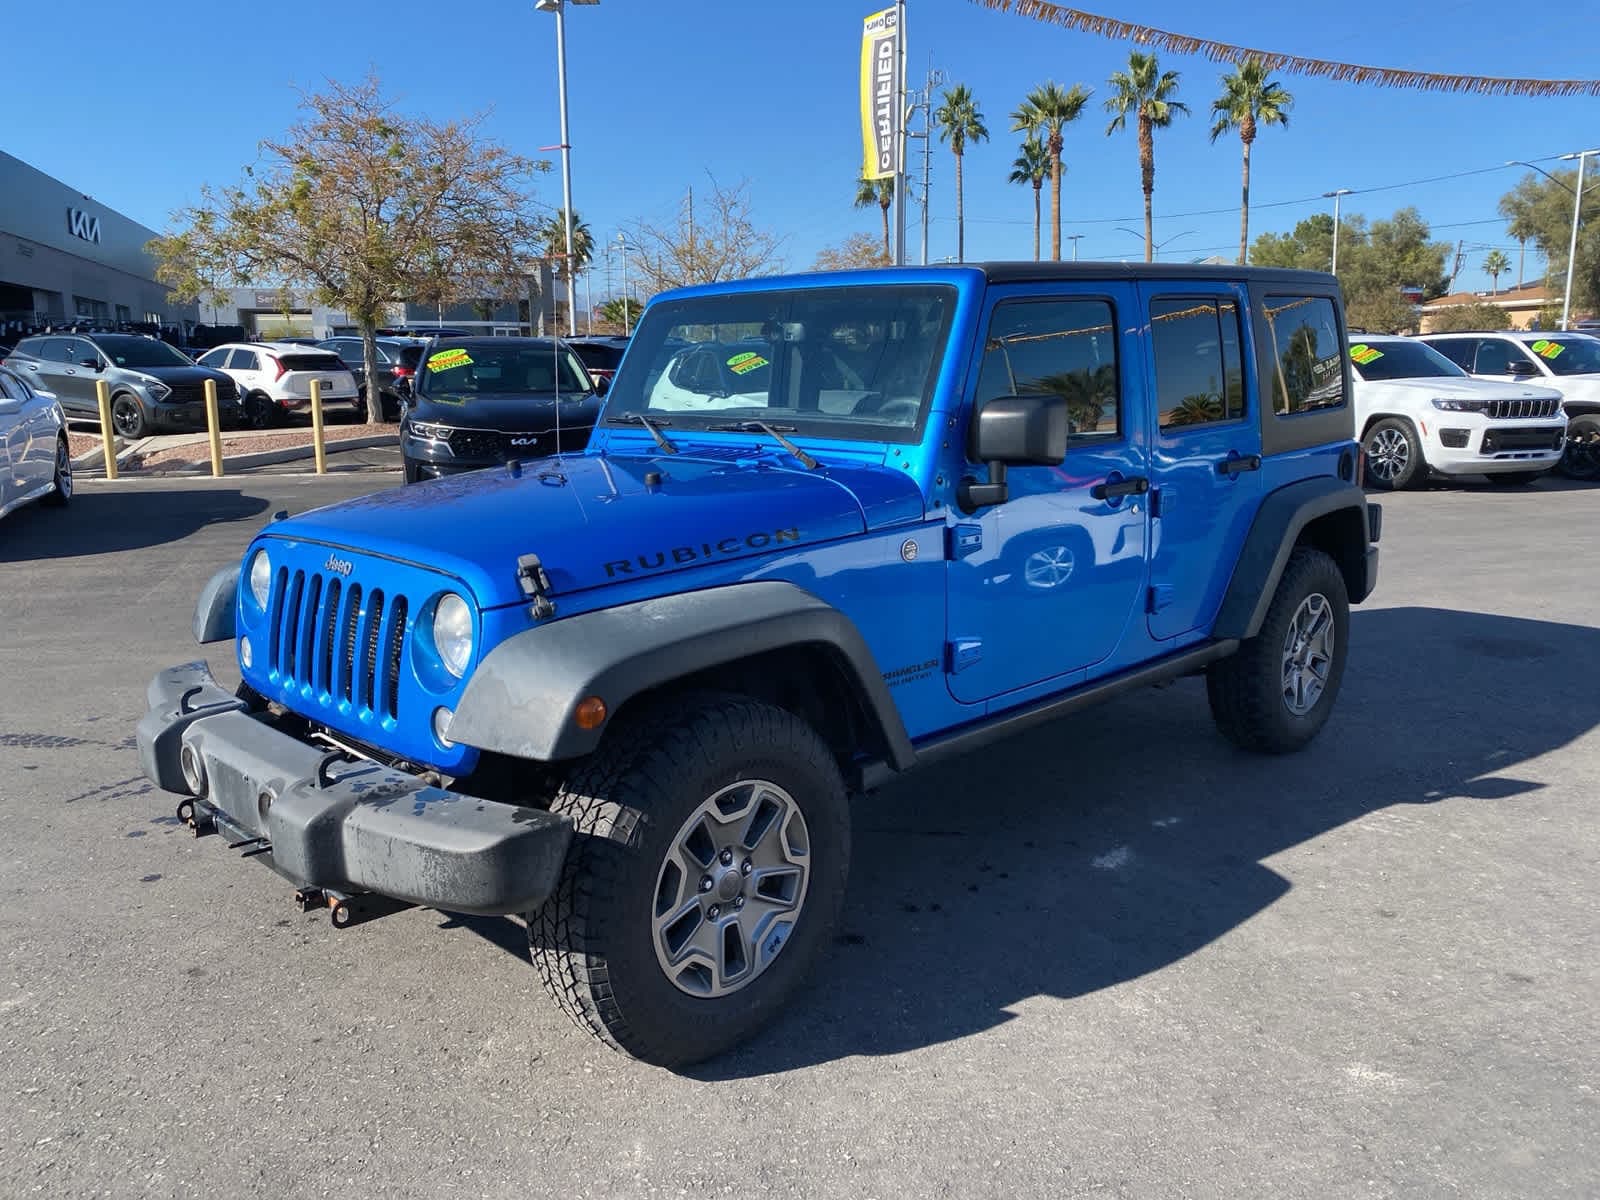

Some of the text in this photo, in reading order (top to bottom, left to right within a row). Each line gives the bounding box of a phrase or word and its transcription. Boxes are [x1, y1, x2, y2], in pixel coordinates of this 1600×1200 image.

[67, 207, 102, 244] KIA
[511, 438, 537, 446] KIA
[325, 553, 352, 576] Jeep
[603, 526, 801, 577] RUBICON
